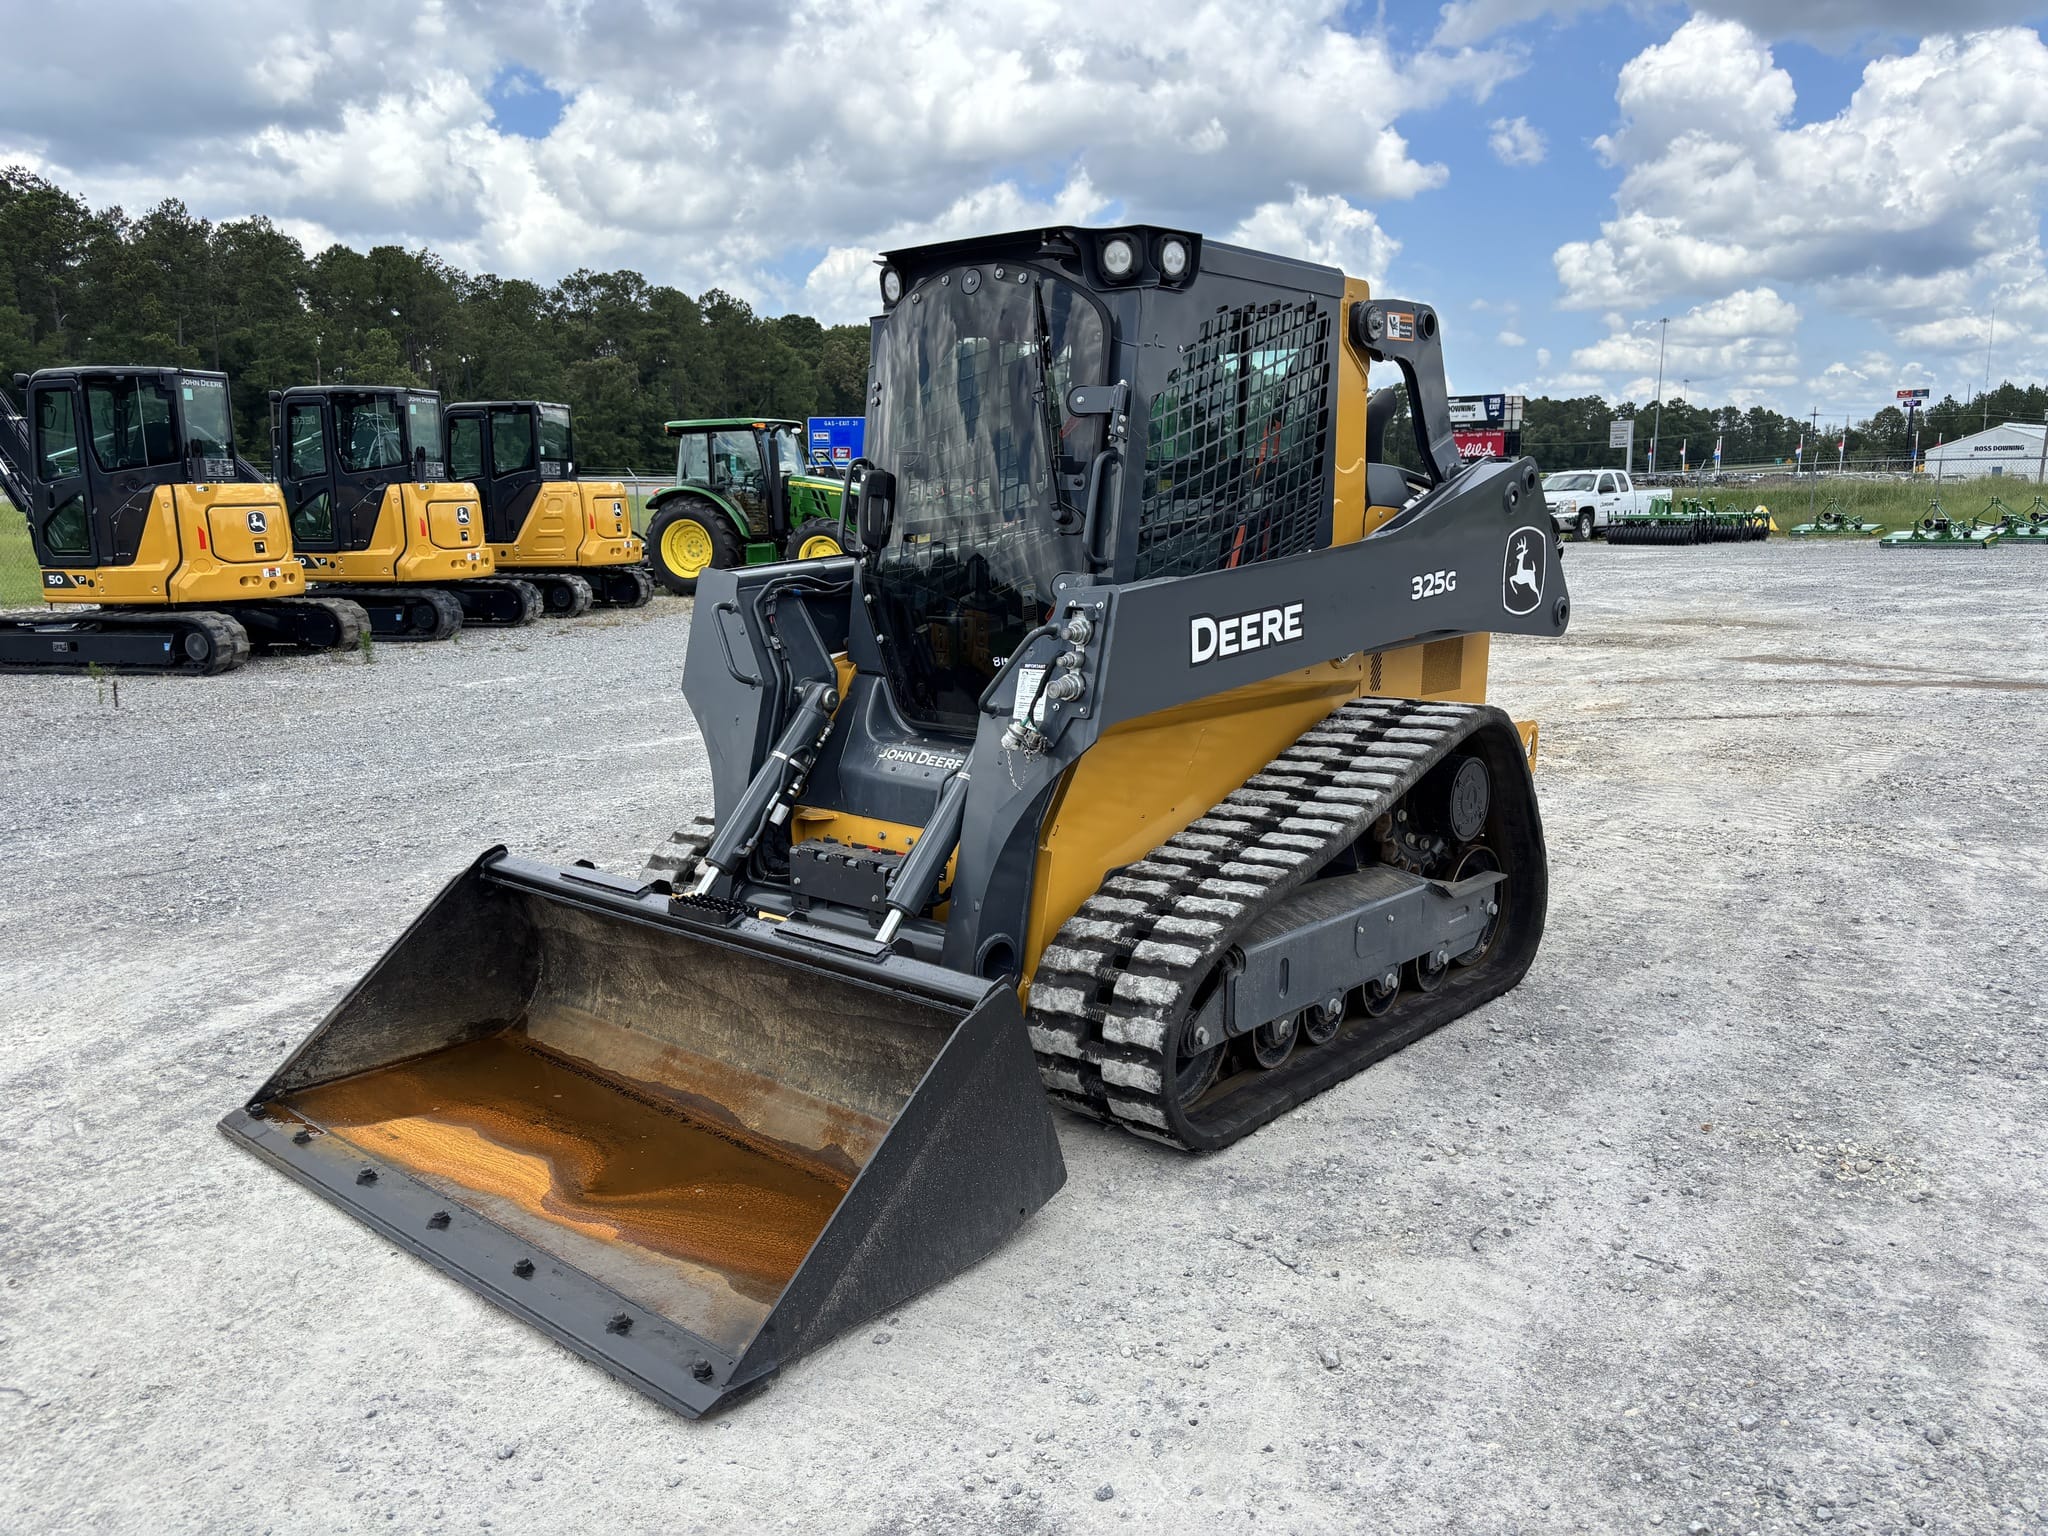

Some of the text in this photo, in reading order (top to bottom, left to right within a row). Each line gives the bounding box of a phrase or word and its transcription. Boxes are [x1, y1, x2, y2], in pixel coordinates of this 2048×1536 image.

[181, 377, 223, 388] JOHN DEERE
[48, 575, 85, 585] 50 P
[1411, 570, 1456, 600] 325G
[1191, 603, 1303, 664] DEERE
[879, 748, 964, 769] JOHN DEERE
